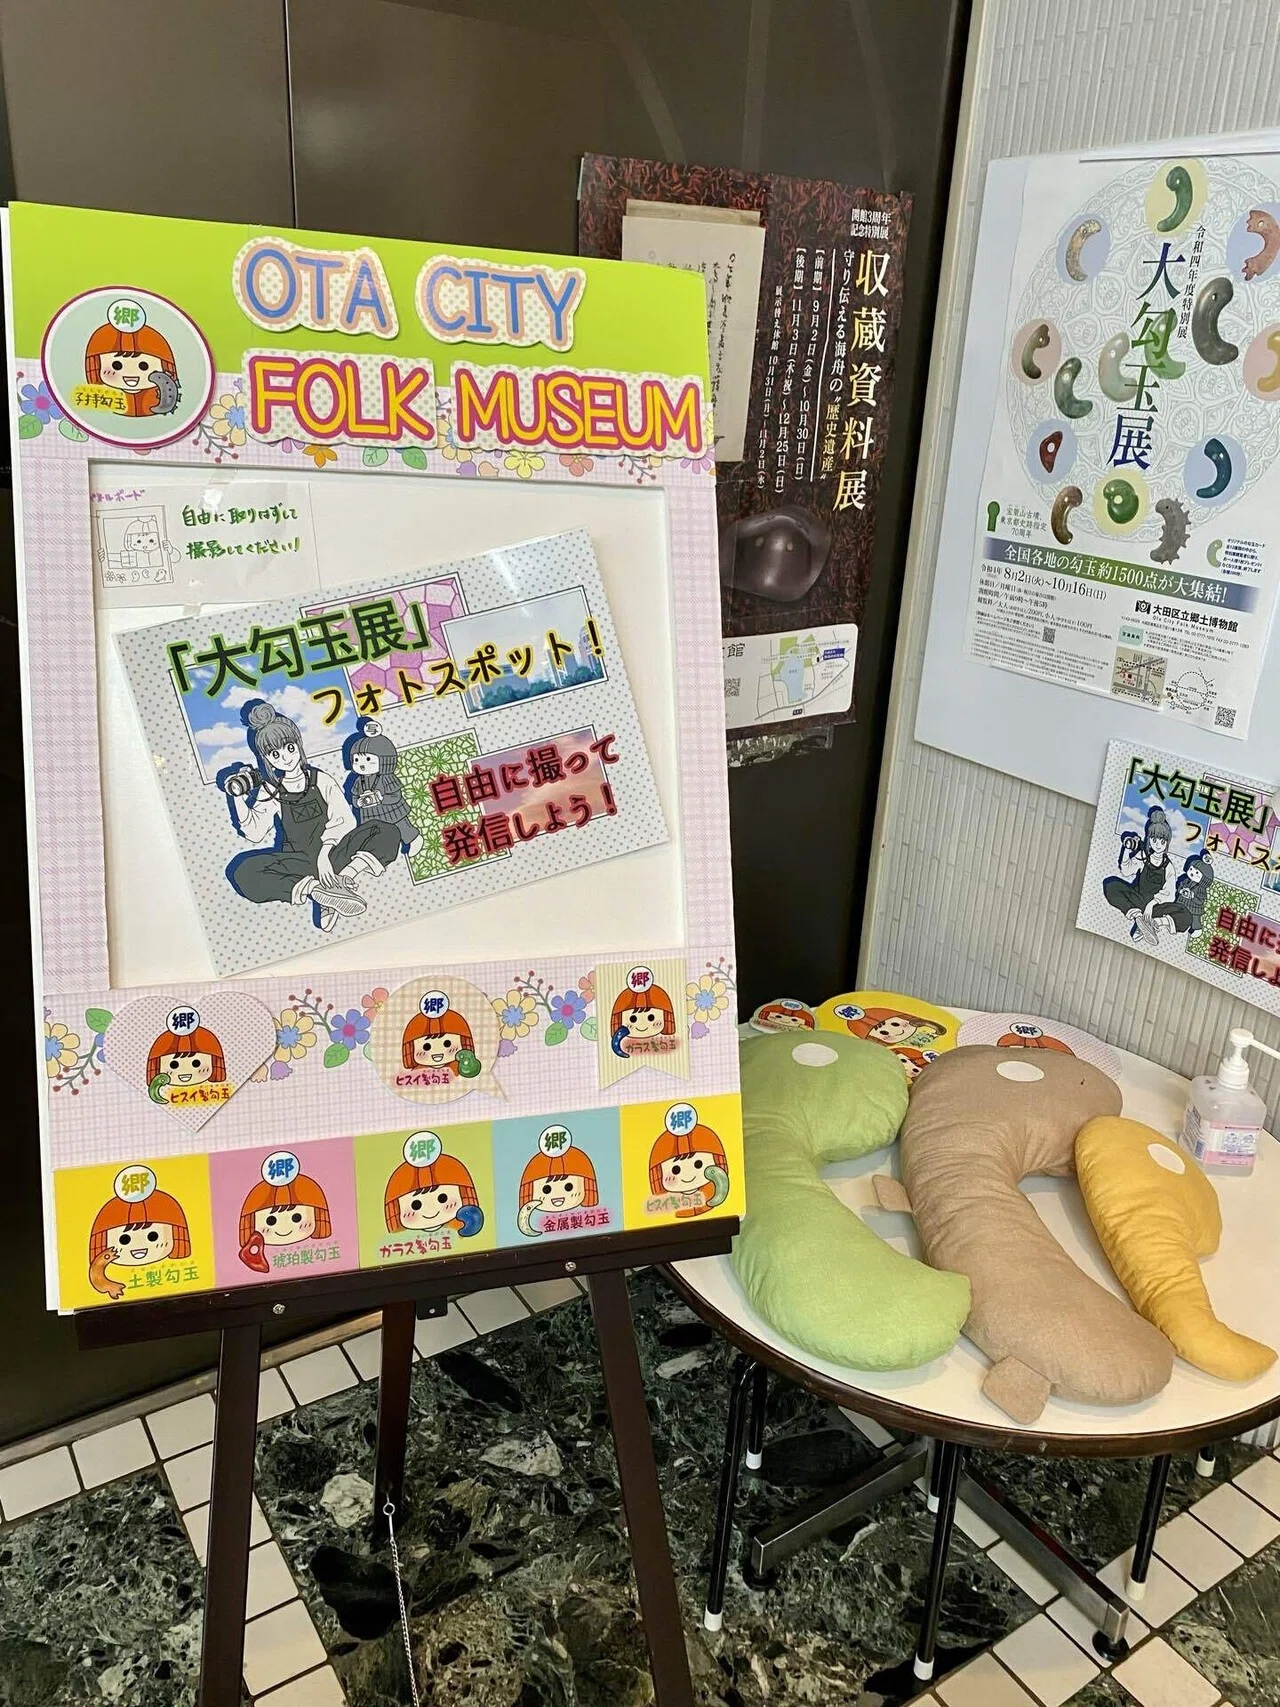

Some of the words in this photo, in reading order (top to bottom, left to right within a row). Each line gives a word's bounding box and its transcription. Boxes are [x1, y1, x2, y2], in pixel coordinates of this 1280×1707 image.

[851, 208, 892, 226] 開館3周年
[850, 224, 889, 240] 記念特別展
[244, 243, 392, 332] OTA
[424, 261, 581, 345] CITY
[1177, 225, 1205, 339] 令和四年度特別展
[113, 306, 140, 328] 郷
[1106, 242, 1186, 470] 大勾玉展
[832, 250, 891, 511] 収蔵資料展
[249, 356, 434, 444] FOLK
[454, 367, 702, 455] MUSEUM
[181, 502, 299, 527] 自由に取りはずして
[1152, 604, 1239, 633] 大田区立郷土博物館
[167, 600, 432, 695] 「大勾玉展」
[430, 734, 621, 813] 自由に撮って
[1129, 757, 1269, 834] 「大勾玉展」
[1185, 821, 1280, 871] フォトス
[1217, 905, 1280, 955] 自由に
[631, 972, 650, 988] 郷
[423, 997, 444, 1014] 郷
[172, 1011, 196, 1031] 郷
[670, 1110, 694, 1131] 郷
[409, 1139, 437, 1161] 郷
[544, 1132, 568, 1152] 郷
[266, 1158, 295, 1180] 郷
[121, 1171, 150, 1195] 郷
[543, 1212, 611, 1233] 金属製勾玉
[272, 1245, 342, 1270] 琥珀製勾玉
[127, 1265, 200, 1291] 土製勾玉
